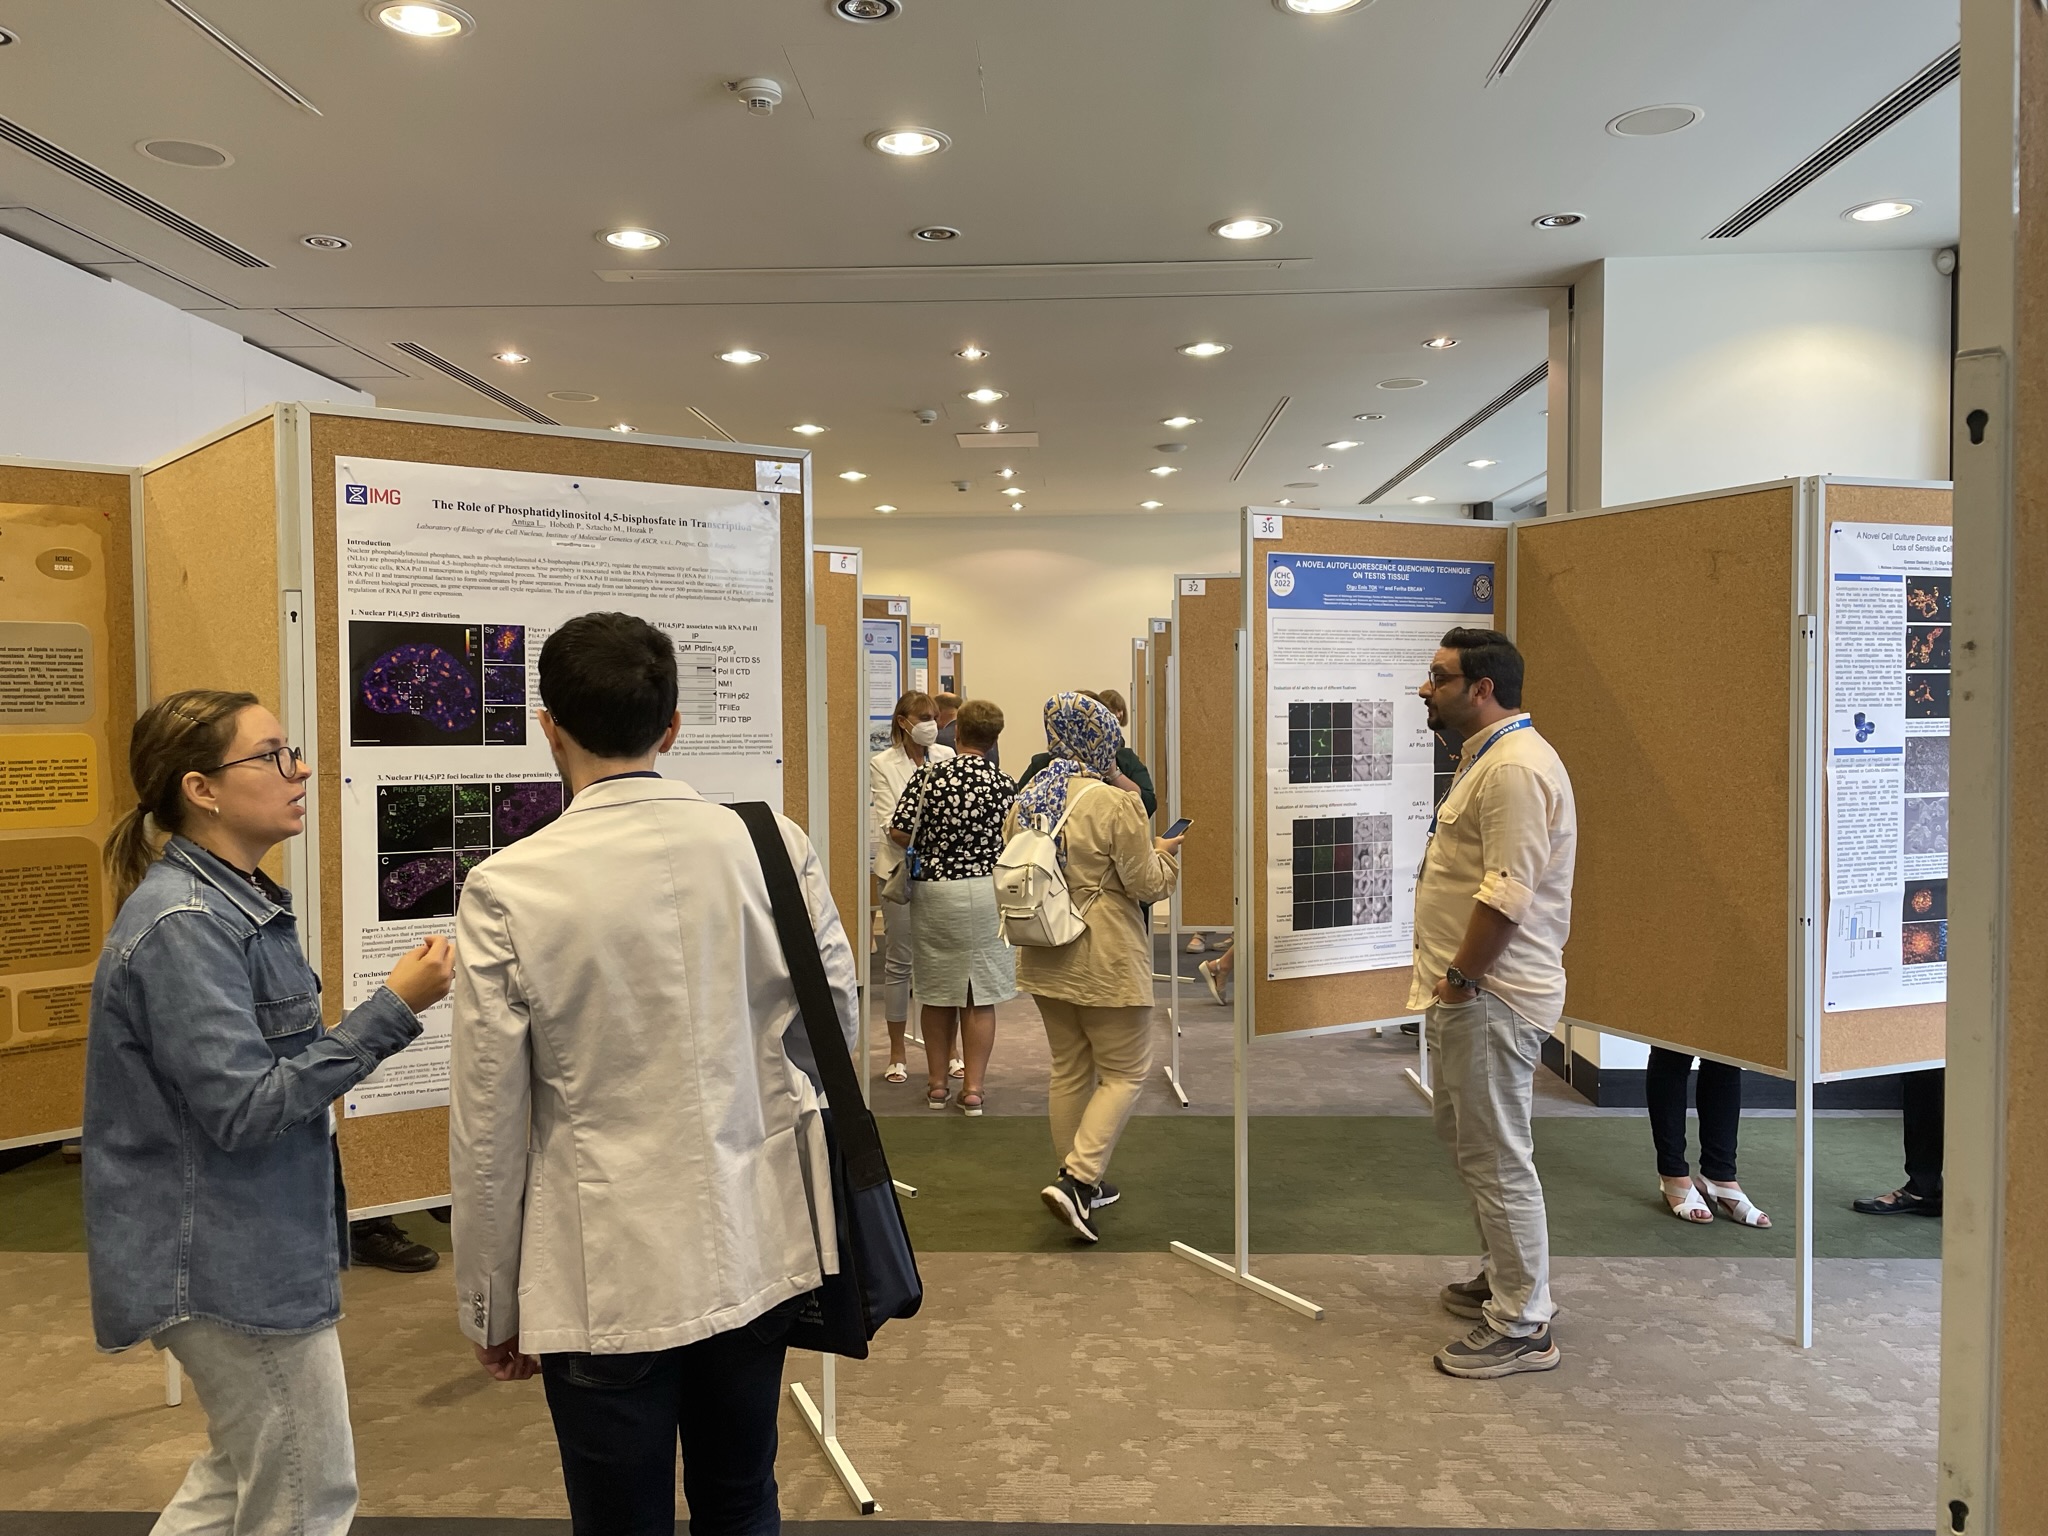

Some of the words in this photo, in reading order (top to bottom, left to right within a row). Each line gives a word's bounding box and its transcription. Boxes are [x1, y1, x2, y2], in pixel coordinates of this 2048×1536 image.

[774, 471, 782, 484] 2
[370, 488, 400, 505] IMG
[432, 500, 453, 510] The
[458, 501, 481, 512] Role
[484, 504, 495, 513] of
[498, 505, 601, 521] Phosphatidylinositol
[604, 513, 676, 526] 4,5-bisphosfate
[679, 518, 688, 527] in
[691, 519, 755, 533] Transcription
[550, 520, 574, 529] Hoboth
[1262, 522, 1274, 533] 36
[462, 526, 485, 534] Biology
[1894, 533, 1915, 541] Culture
[1916, 534, 1936, 542] Device
[348, 539, 391, 547] Introduction
[1915, 544, 1941, 552] Sensitive
[841, 560, 847, 568] 6
[1302, 561, 1325, 569] NOVEL
[1326, 562, 1396, 572] AUTOFLUORESCENCE
[1398, 565, 1435, 573] QUENCHING
[1436, 566, 1470, 575] TECHNIQUE
